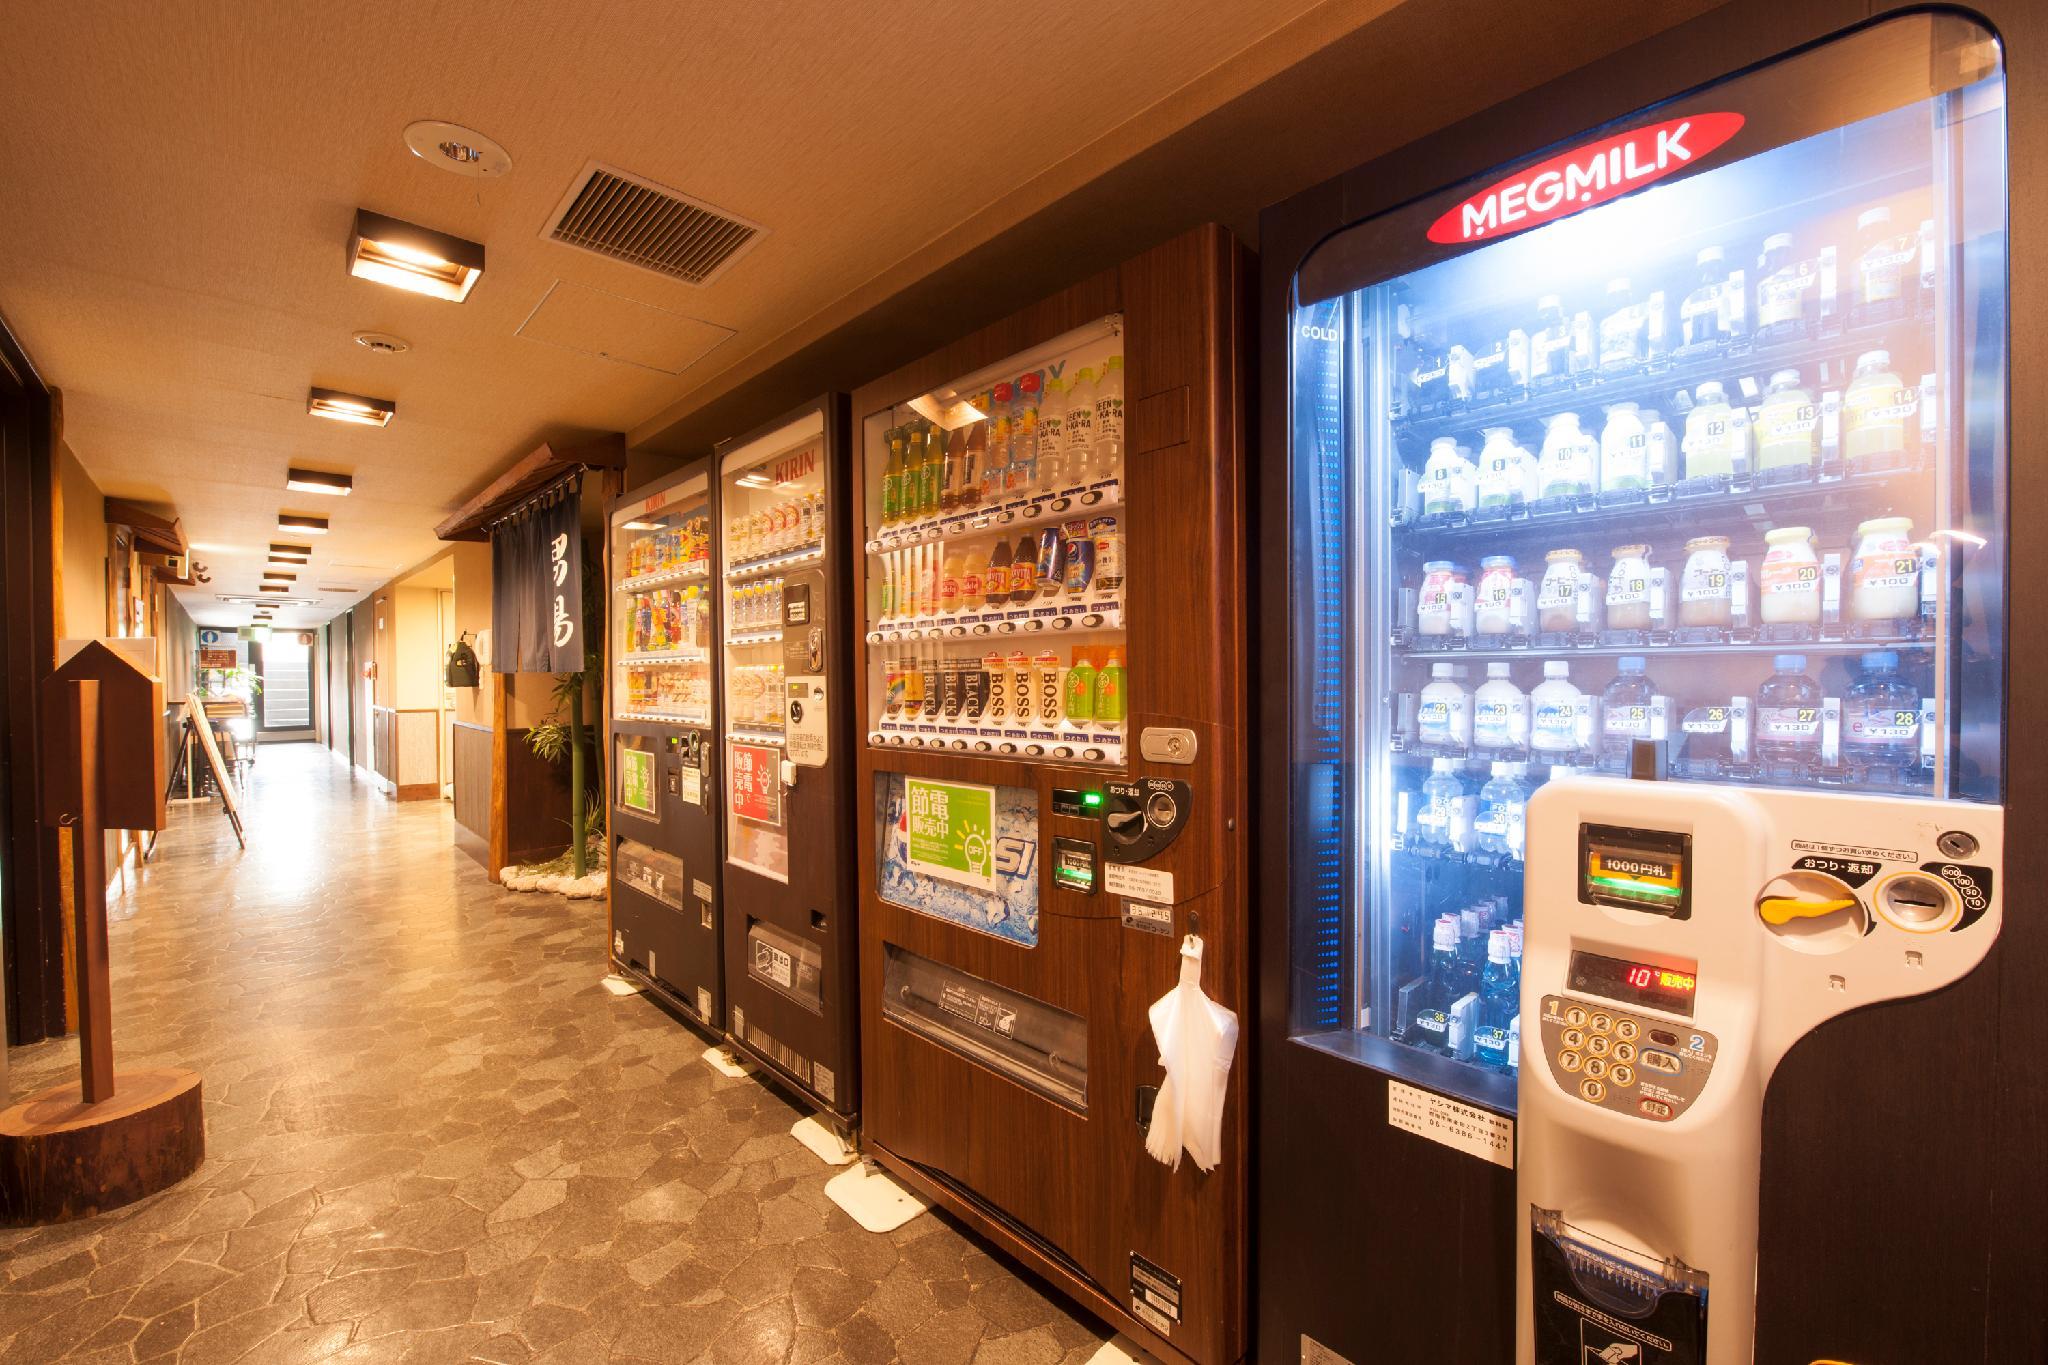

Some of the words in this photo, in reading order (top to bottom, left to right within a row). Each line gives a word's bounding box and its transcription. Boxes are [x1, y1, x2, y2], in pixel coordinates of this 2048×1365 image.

[1462, 122, 1692, 238] MEGMILK
[1899, 238, 1908, 249] 7
[1710, 287, 1718, 298] 5
[1301, 325, 1338, 341] COLD
[1895, 390, 1913, 403] 14
[1798, 406, 1814, 420] 13
[1708, 421, 1724, 435] 12
[1632, 435, 1643, 447] 11
[1559, 448, 1571, 460] 10
[775, 448, 815, 485] KIRIN
[1896, 560, 1915, 574] 21
[1709, 574, 1724, 587] 19
[1799, 567, 1816, 581] 20
[1560, 585, 1572, 597] 17
[1630, 580, 1644, 592] 18
[1436, 593, 1447, 604] 15
[1493, 589, 1505, 601] 16
[924, 675, 936, 713] BLACK
[945, 674, 957, 714] BLACK
[966, 673, 979, 717] BLACK
[991, 673, 1005, 717] BOSS
[1016, 673, 1030, 718] BOSS
[1043, 672, 1058, 719] BOSS
[1435, 703, 1447, 714] 22
[1494, 704, 1506, 715] 23
[1559, 705, 1573, 717] 24
[1630, 707, 1645, 720] 25
[1708, 708, 1724, 720] 26
[1798, 709, 1815, 722] 27
[1896, 712, 1914, 725] 28
[1775, 723, 1810, 732] ¥130
[911, 786, 949, 821] 節電
[1493, 813, 1506, 824] 30
[912, 815, 949, 839] 販売中
[969, 845, 983, 856] OFF
[1605, 858, 1667, 878] 1000円札
[1804, 858, 1873, 875] おつり・返却
[1943, 868, 1960, 877] 500
[1957, 877, 1972, 887] 100
[1966, 888, 1978, 897] 50
[1970, 898, 1981, 907] 10
[1627, 967, 1651, 987] 10
[1660, 970, 1695, 991] 販売中
[1548, 1000, 1559, 1016] 1
[1434, 1012, 1445, 1022] 36
[1573, 1011, 1580, 1023] 1
[1596, 1017, 1606, 1029] 2
[1493, 1030, 1505, 1040] 37
[1622, 1024, 1632, 1036] 3
[1569, 1032, 1579, 1045] 4
[1594, 1038, 1604, 1051] 5
[1689, 1034, 1705, 1051] 2
[1619, 1046, 1630, 1059] 6
[1566, 1055, 1576, 1067] 7
[1590, 1061, 1601, 1073] 8
[1646, 1053, 1678, 1073] 購入
[1617, 1069, 1627, 1081] 9
[1588, 1084, 1597, 1096] 0
